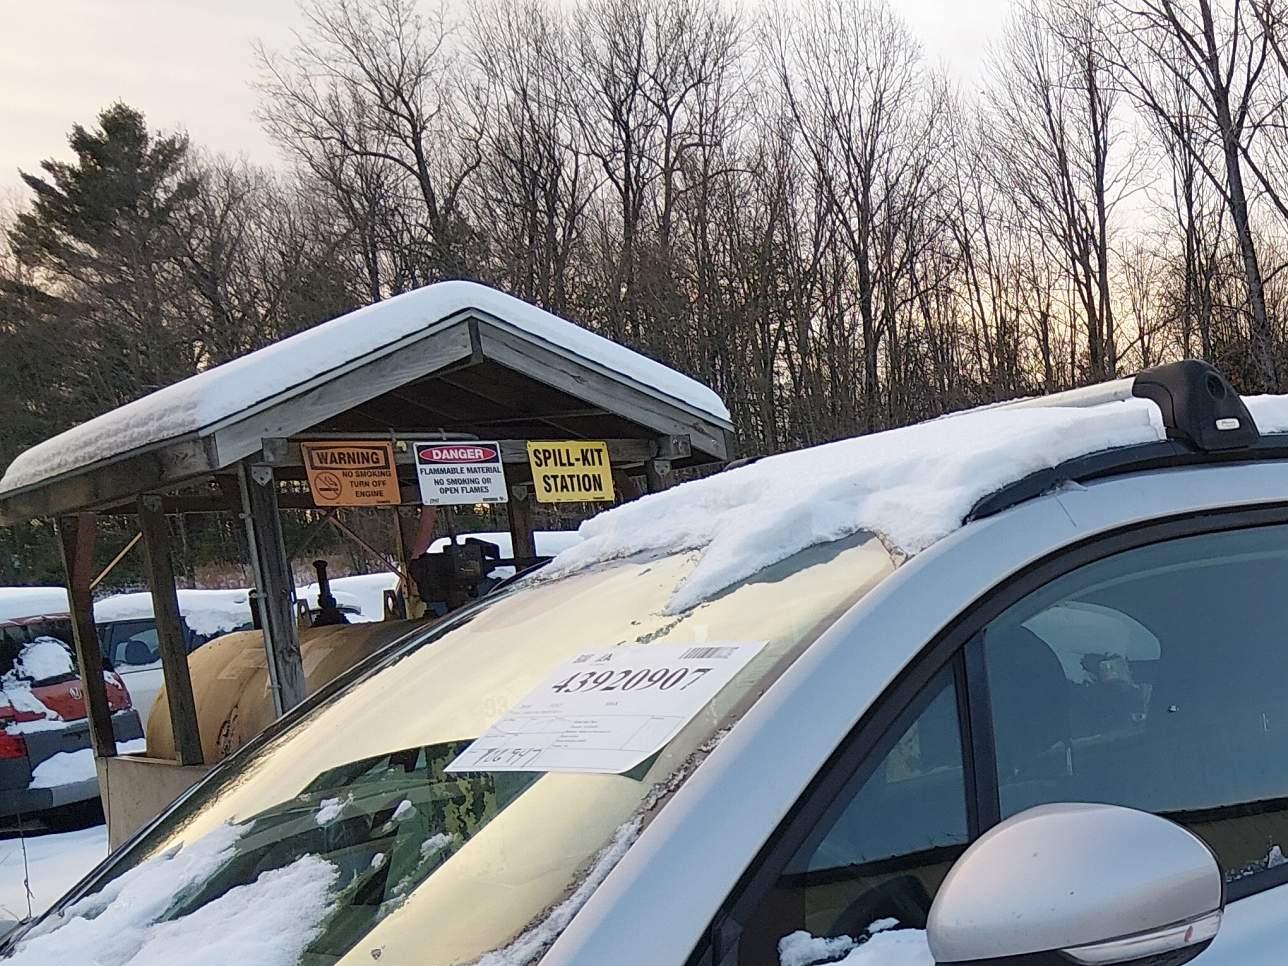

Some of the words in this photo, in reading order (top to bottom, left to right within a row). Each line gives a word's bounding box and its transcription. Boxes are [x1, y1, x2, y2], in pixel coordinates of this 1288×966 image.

[316, 451, 380, 465] WARNING
[432, 449, 484, 460] DANGER
[533, 448, 603, 468] SPILL-KIT
[355, 470, 392, 478] SMOKING
[420, 467, 465, 475] FLAMMABLE
[467, 466, 502, 474] MATERIAL
[350, 480, 370, 488] TURN
[372, 480, 387, 488] OFF
[447, 478, 480, 486] SMOKING
[482, 477, 492, 485] OR
[543, 474, 603, 493] STATION
[355, 490, 384, 498] ENGINE
[440, 487, 459, 495] OPEN
[462, 486, 489, 494] FLAMES
[551, 667, 712, 693] 43920907
